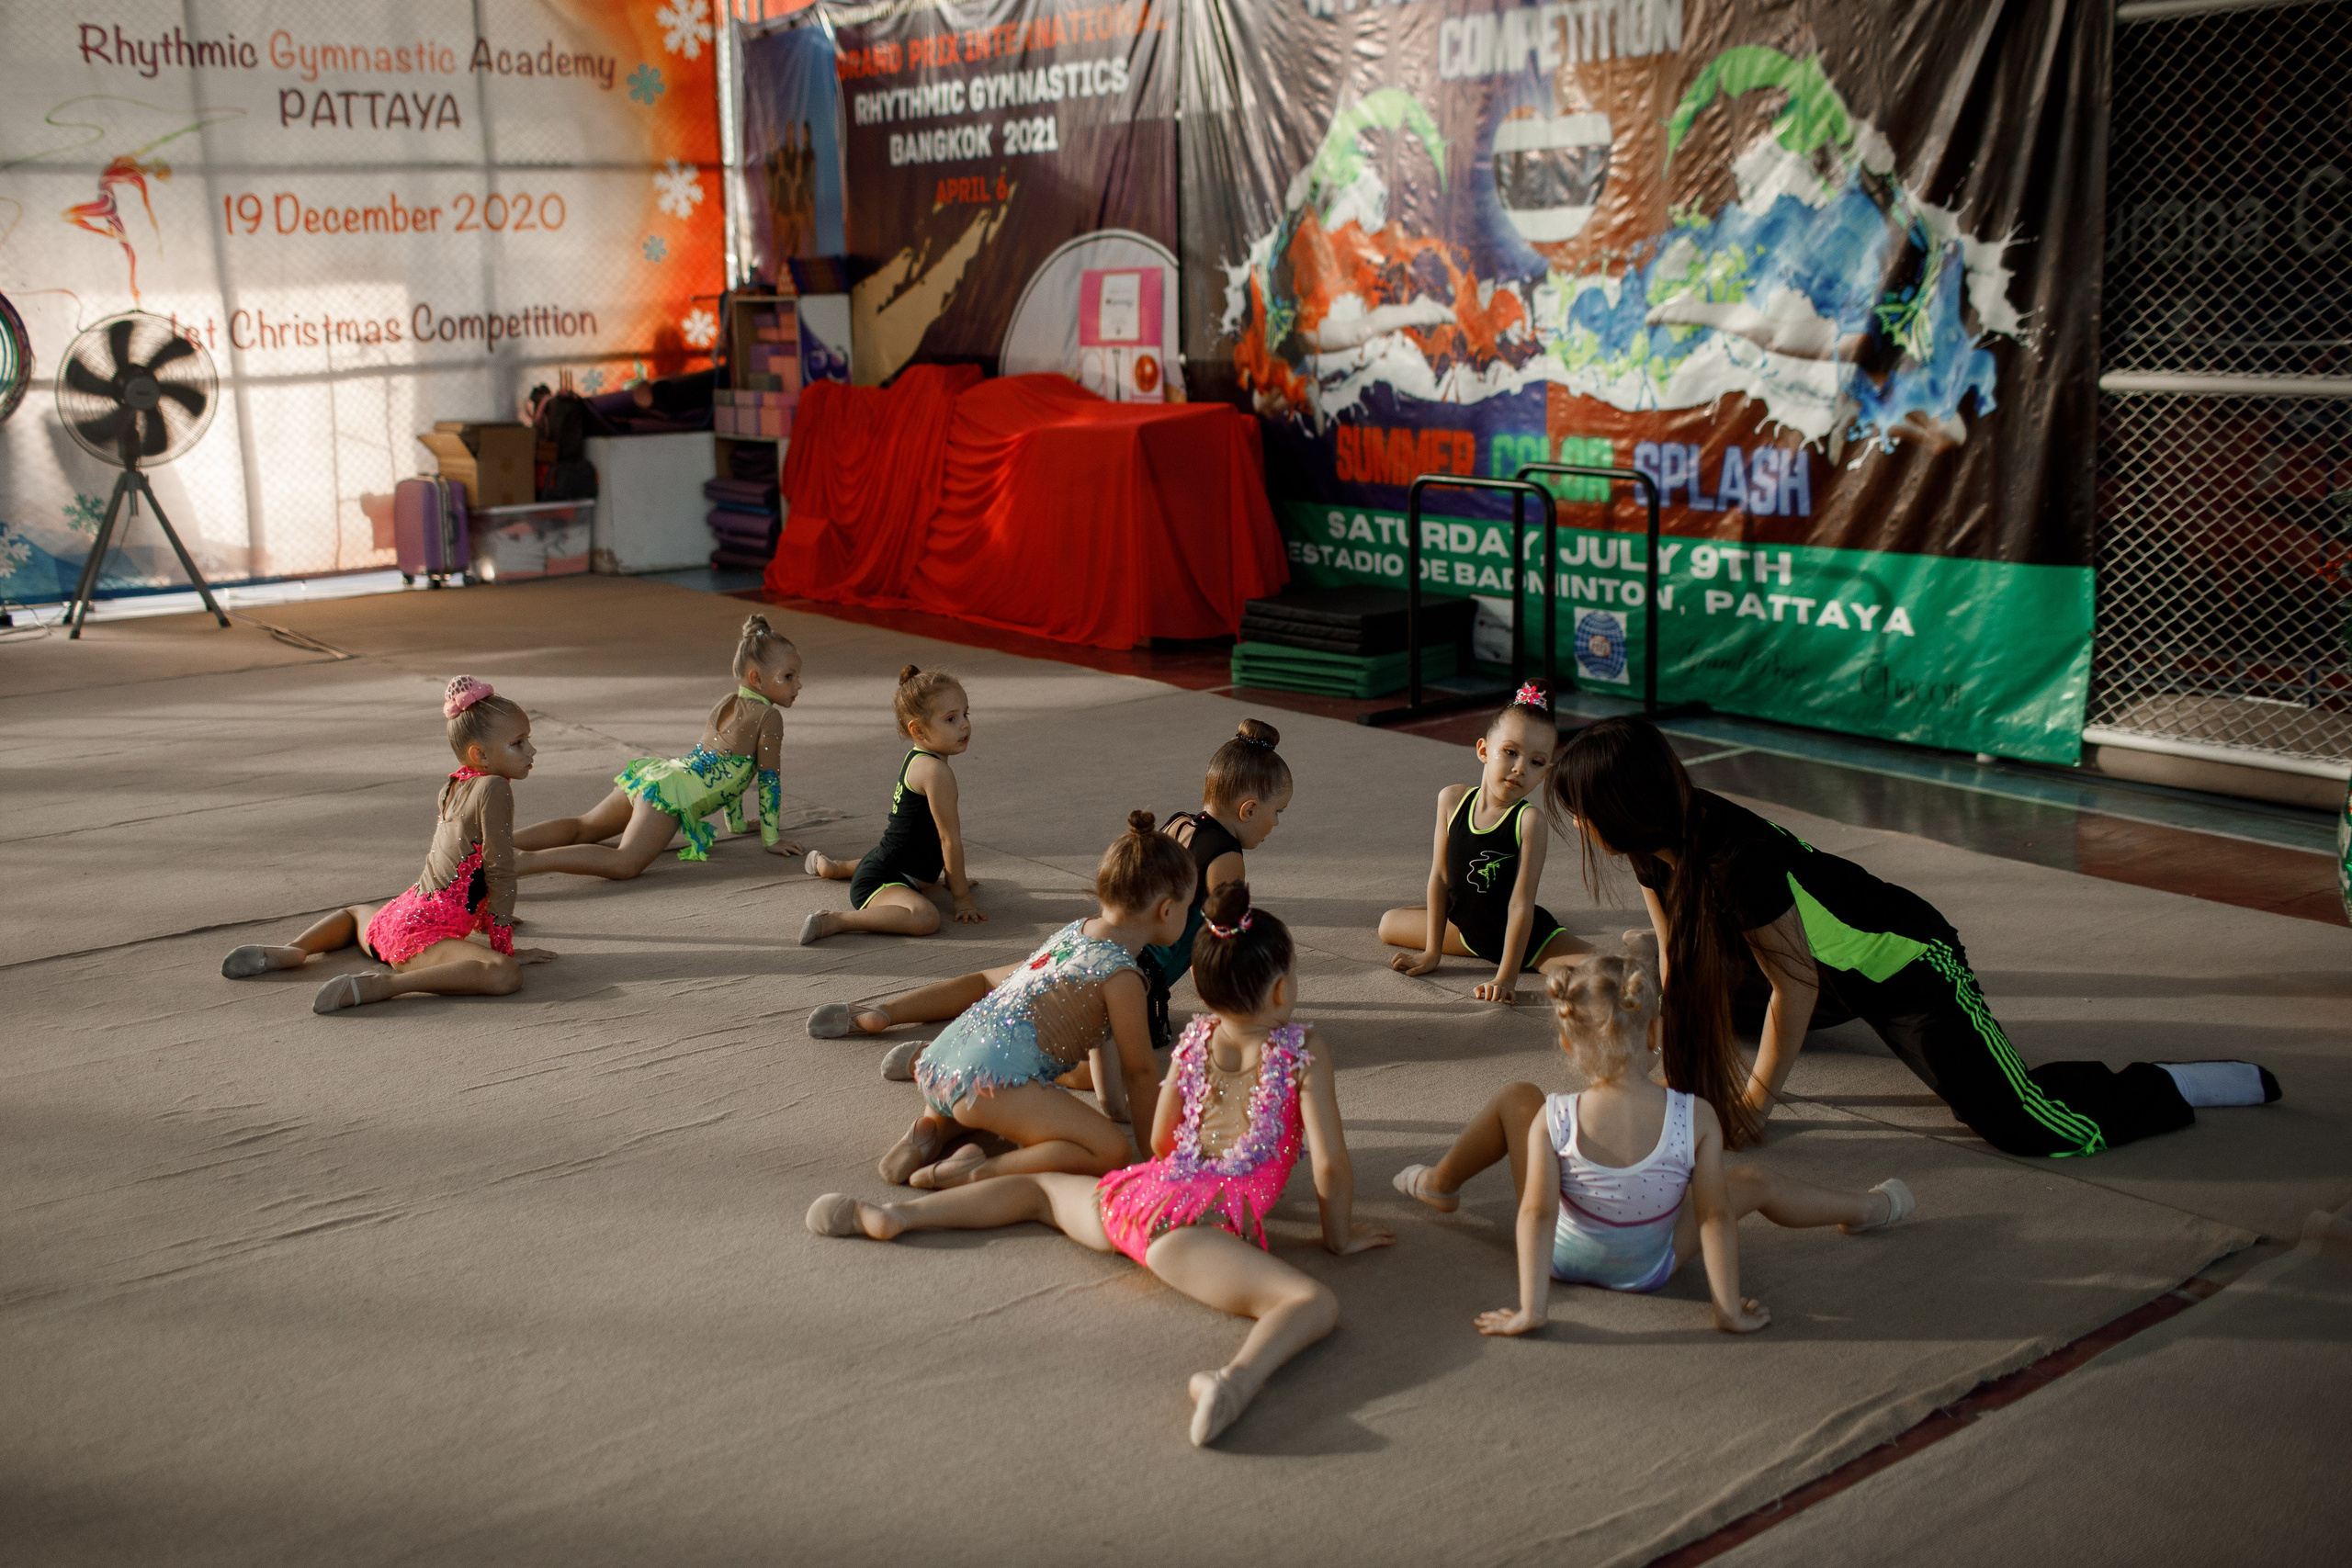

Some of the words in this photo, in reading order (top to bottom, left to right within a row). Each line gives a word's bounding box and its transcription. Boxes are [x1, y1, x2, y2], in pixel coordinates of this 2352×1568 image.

[78, 22, 259, 78] Rhythmic
[269, 29, 457, 83] Gymnastic
[469, 36, 616, 91] Academy
[908, 33, 961, 71] PRIX
[1438, 0, 1683, 80] COMPETITION
[278, 88, 461, 131] PATTAYA
[854, 80, 965, 126] RHYTHMIC
[968, 57, 1130, 113] GYMNASTICS
[888, 122, 994, 167] BANGKOK
[1002, 116, 1058, 156] 2021
[223, 193, 264, 236] 19
[275, 192, 443, 235] December
[453, 192, 567, 233] 2020
[935, 177, 992, 206] APRIL
[231, 309, 402, 351] Christmas
[412, 302, 600, 354] Competition
[1336, 424, 1476, 491] SUMMER
[1490, 433, 1615, 504] COLOR
[1633, 438, 1813, 517] SPLASH
[1559, 535, 1683, 576] JULY
[1690, 545, 1792, 586] 9TH
[1288, 540, 1405, 578] ESTADIO
[1704, 589, 1916, 637] PATTAYA
